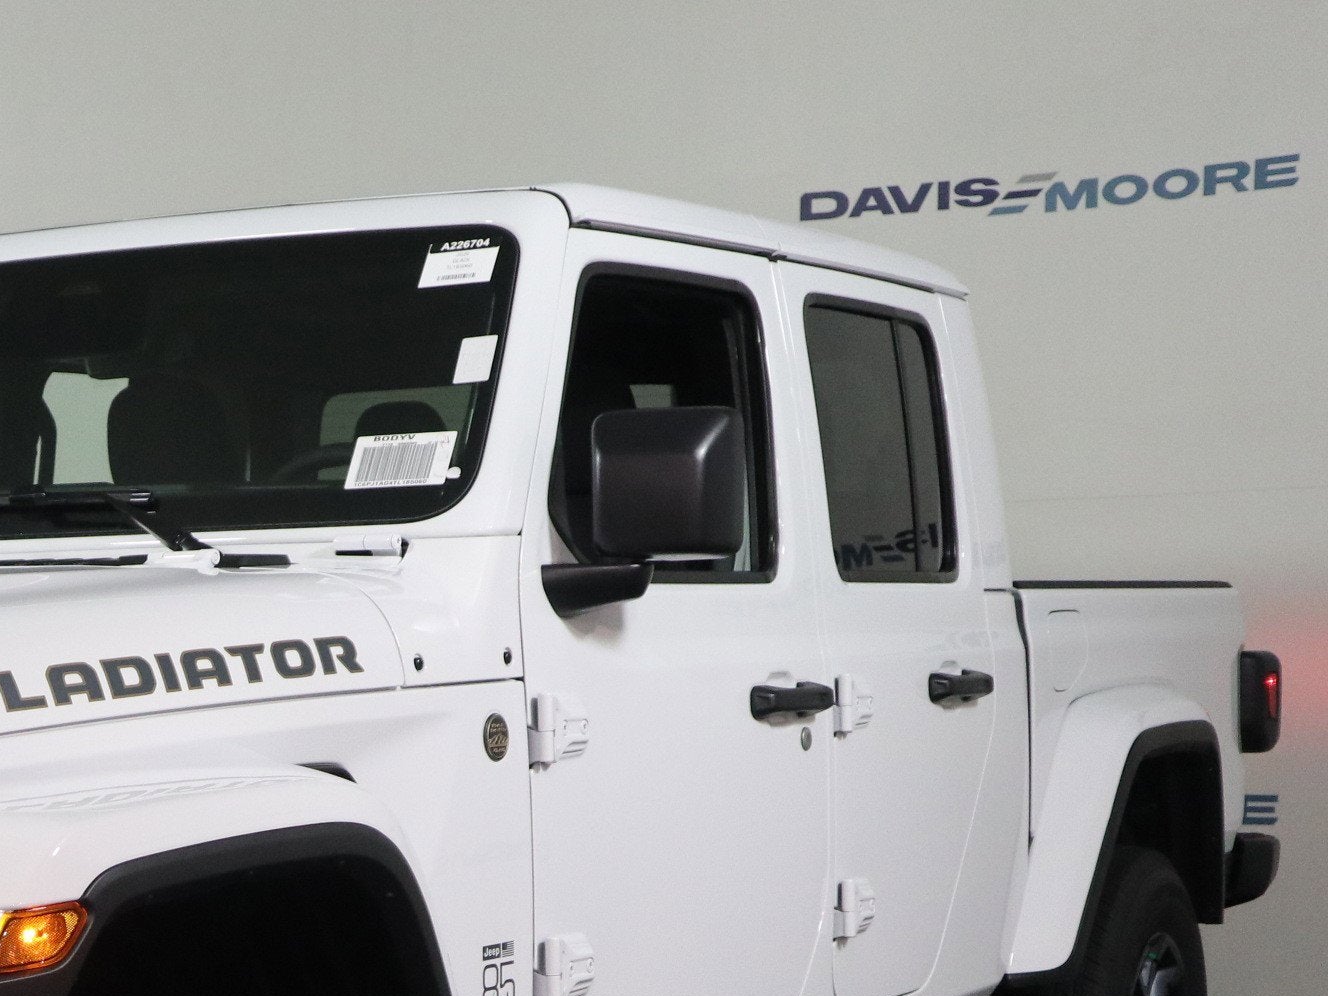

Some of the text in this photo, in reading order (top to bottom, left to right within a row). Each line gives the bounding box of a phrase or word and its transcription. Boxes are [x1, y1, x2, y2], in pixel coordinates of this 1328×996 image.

[799, 153, 1301, 221] DAVIS MOORE
[440, 238, 490, 251] A226704
[483, 945, 500, 959] Jeep
